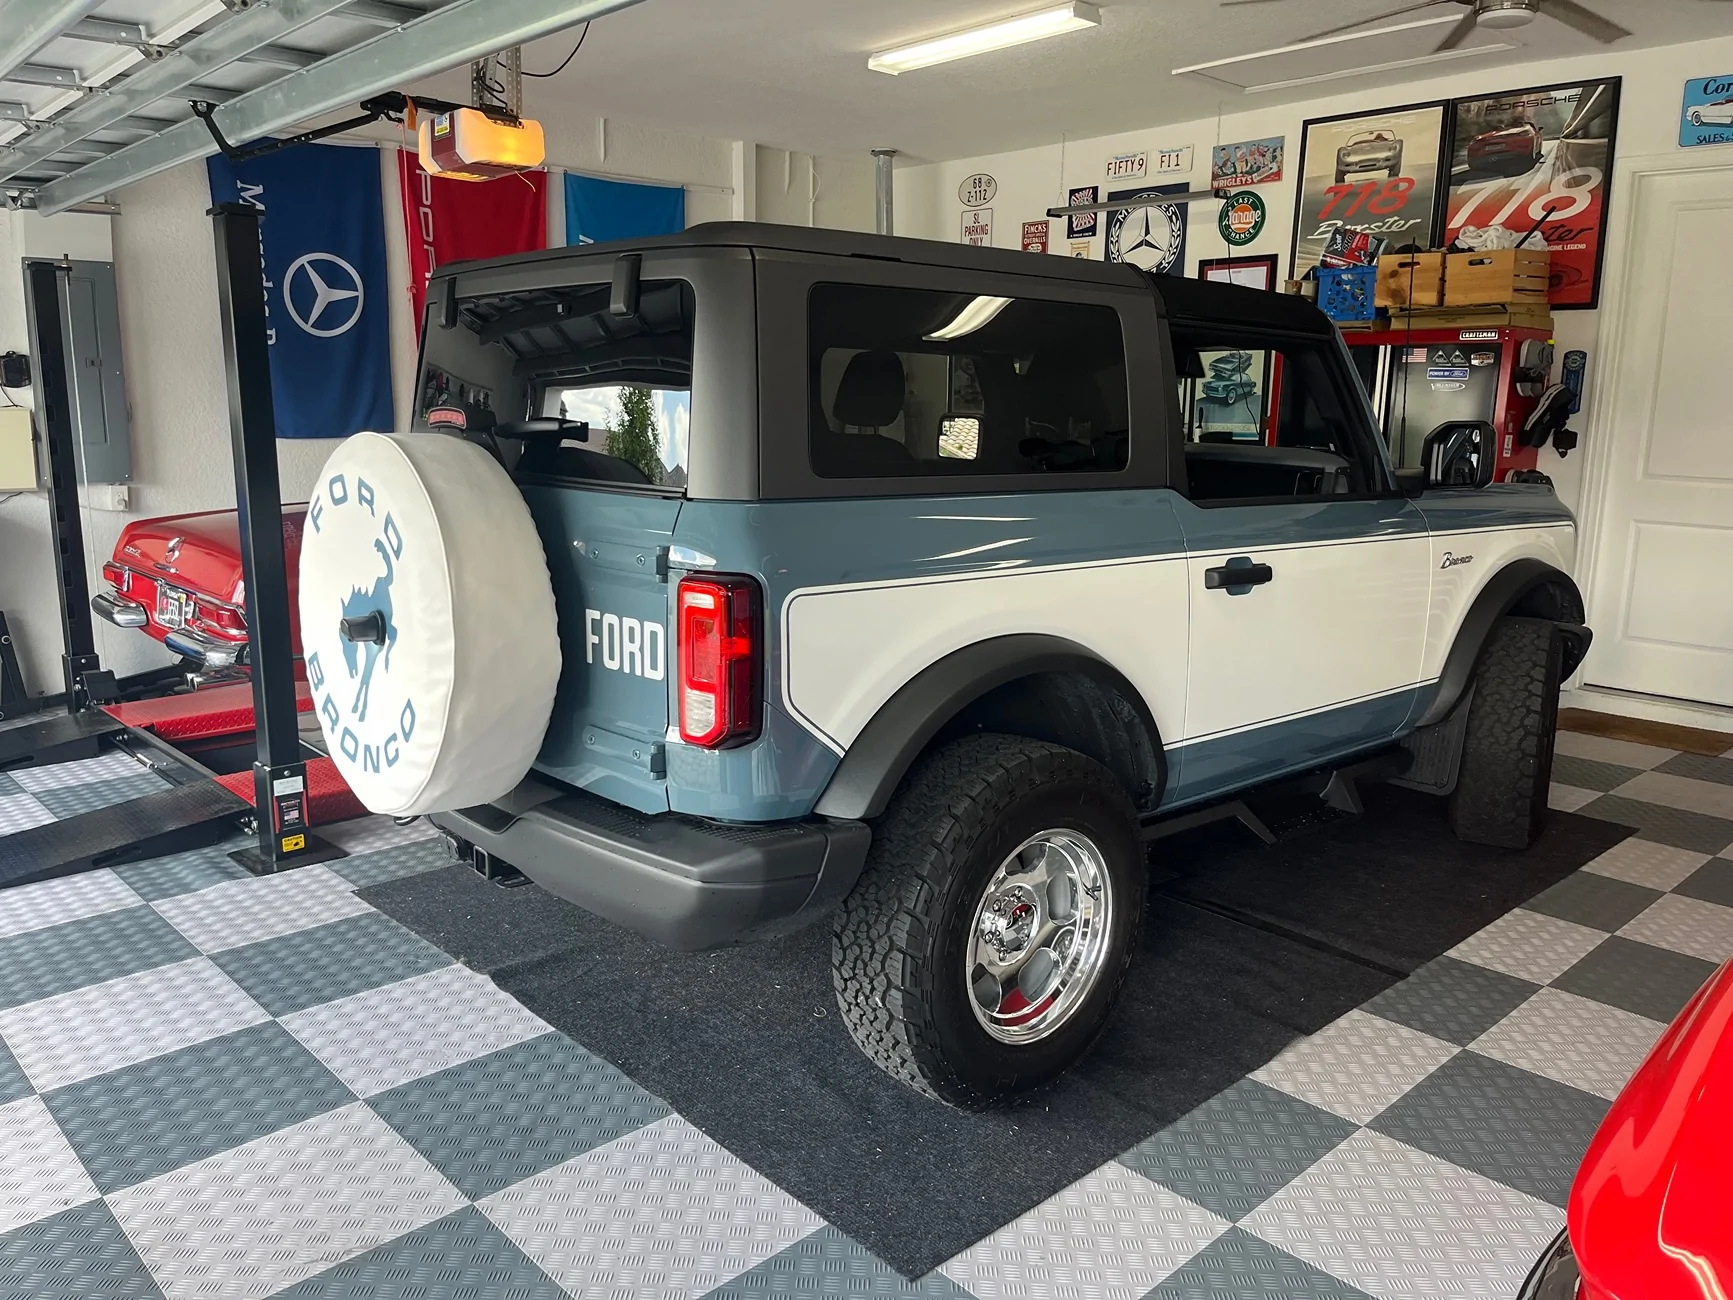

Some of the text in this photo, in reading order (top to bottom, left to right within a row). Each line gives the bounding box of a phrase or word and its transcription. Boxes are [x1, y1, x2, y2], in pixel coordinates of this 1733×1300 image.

[1485, 94, 1581, 113] PORSCHE
[1331, 115, 1417, 132] PORSCHE
[1696, 133, 1725, 144] SALES
[1106, 157, 1145, 176] FIFTY 9
[972, 177, 983, 190] 68
[967, 189, 988, 203] Z-112
[1233, 197, 1254, 207] LAST
[1317, 176, 1416, 220] 718
[1448, 166, 1603, 229] 718
[973, 212, 981, 224] SL
[964, 223, 989, 238] PARKING
[1023, 236, 1046, 245] OVERALLS
[310, 473, 403, 561] FORD
[1440, 551, 1474, 569] Bronco
[585, 608, 665, 681] FORD
[307, 650, 416, 774] BRONCO
